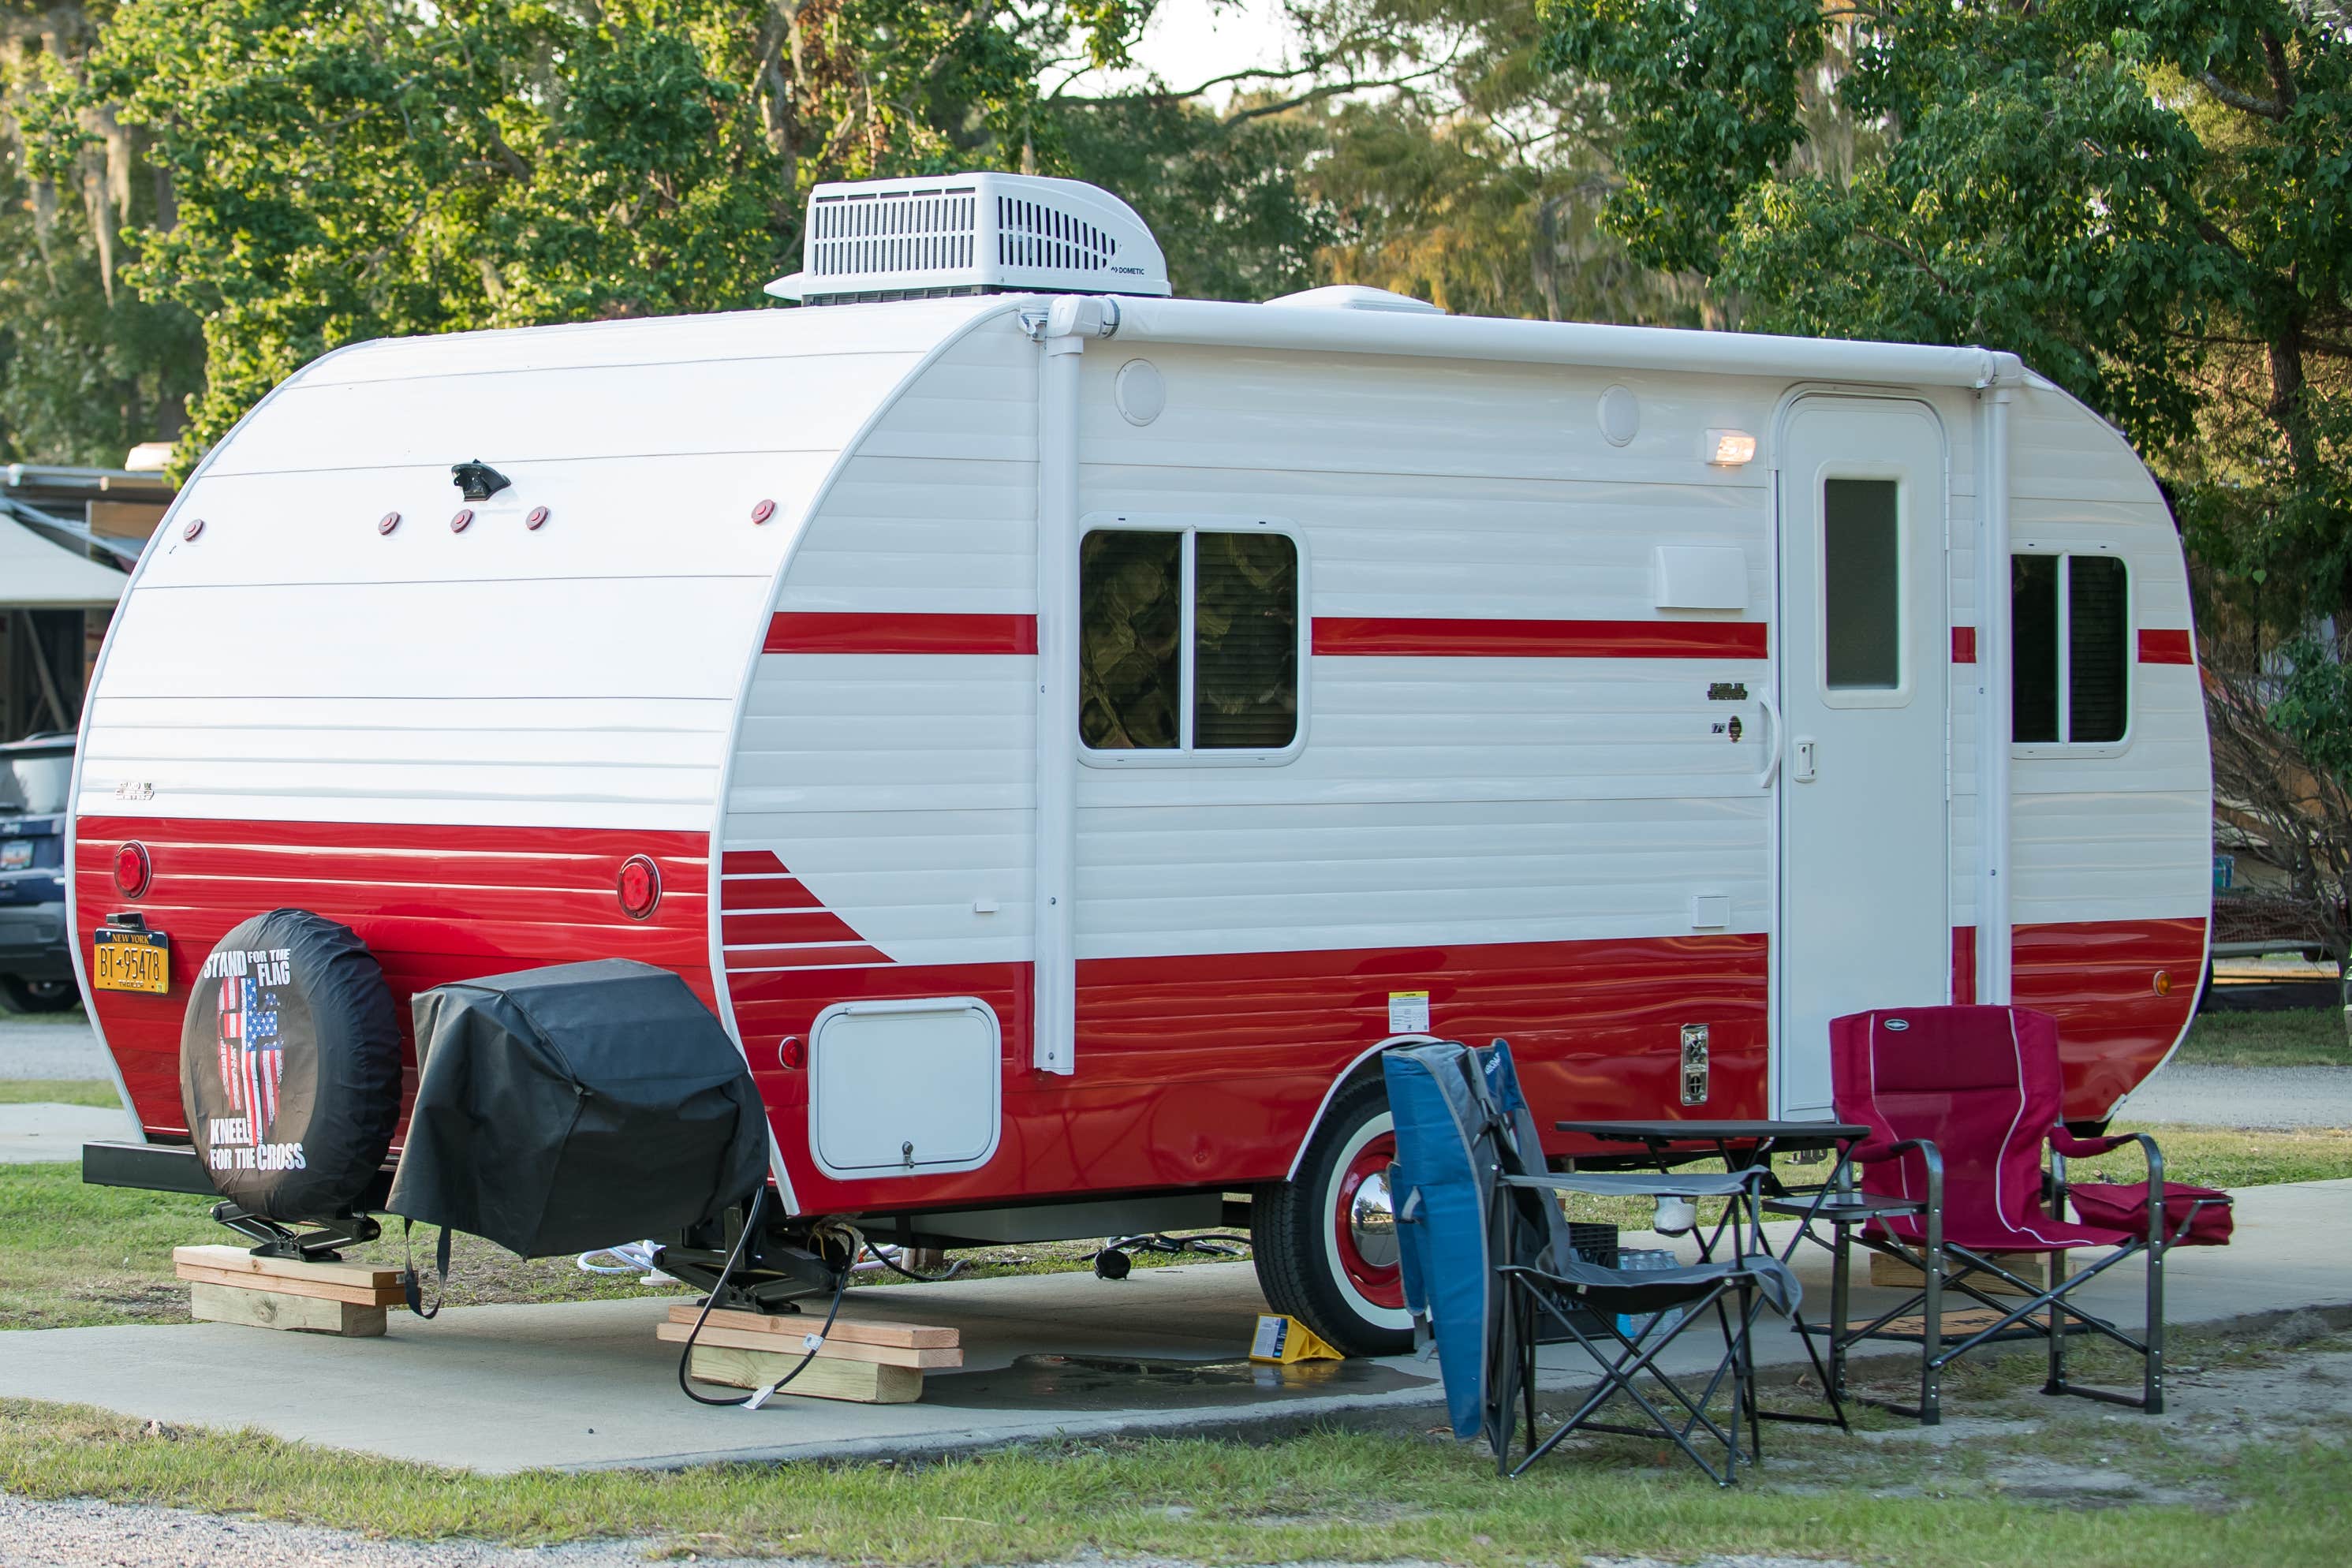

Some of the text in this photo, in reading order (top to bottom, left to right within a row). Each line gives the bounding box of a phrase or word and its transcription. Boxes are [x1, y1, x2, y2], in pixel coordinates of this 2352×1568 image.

[1118, 267, 1144, 275] DOMETIC
[112, 933, 149, 944] NEW YORK
[100, 946, 159, 981] BT 95478
[203, 948, 291, 979] STAND FOR THE
[256, 961, 291, 987] FLAG
[210, 1118, 250, 1145] KNEEL
[210, 1142, 306, 1170] FOR THE CROSS
